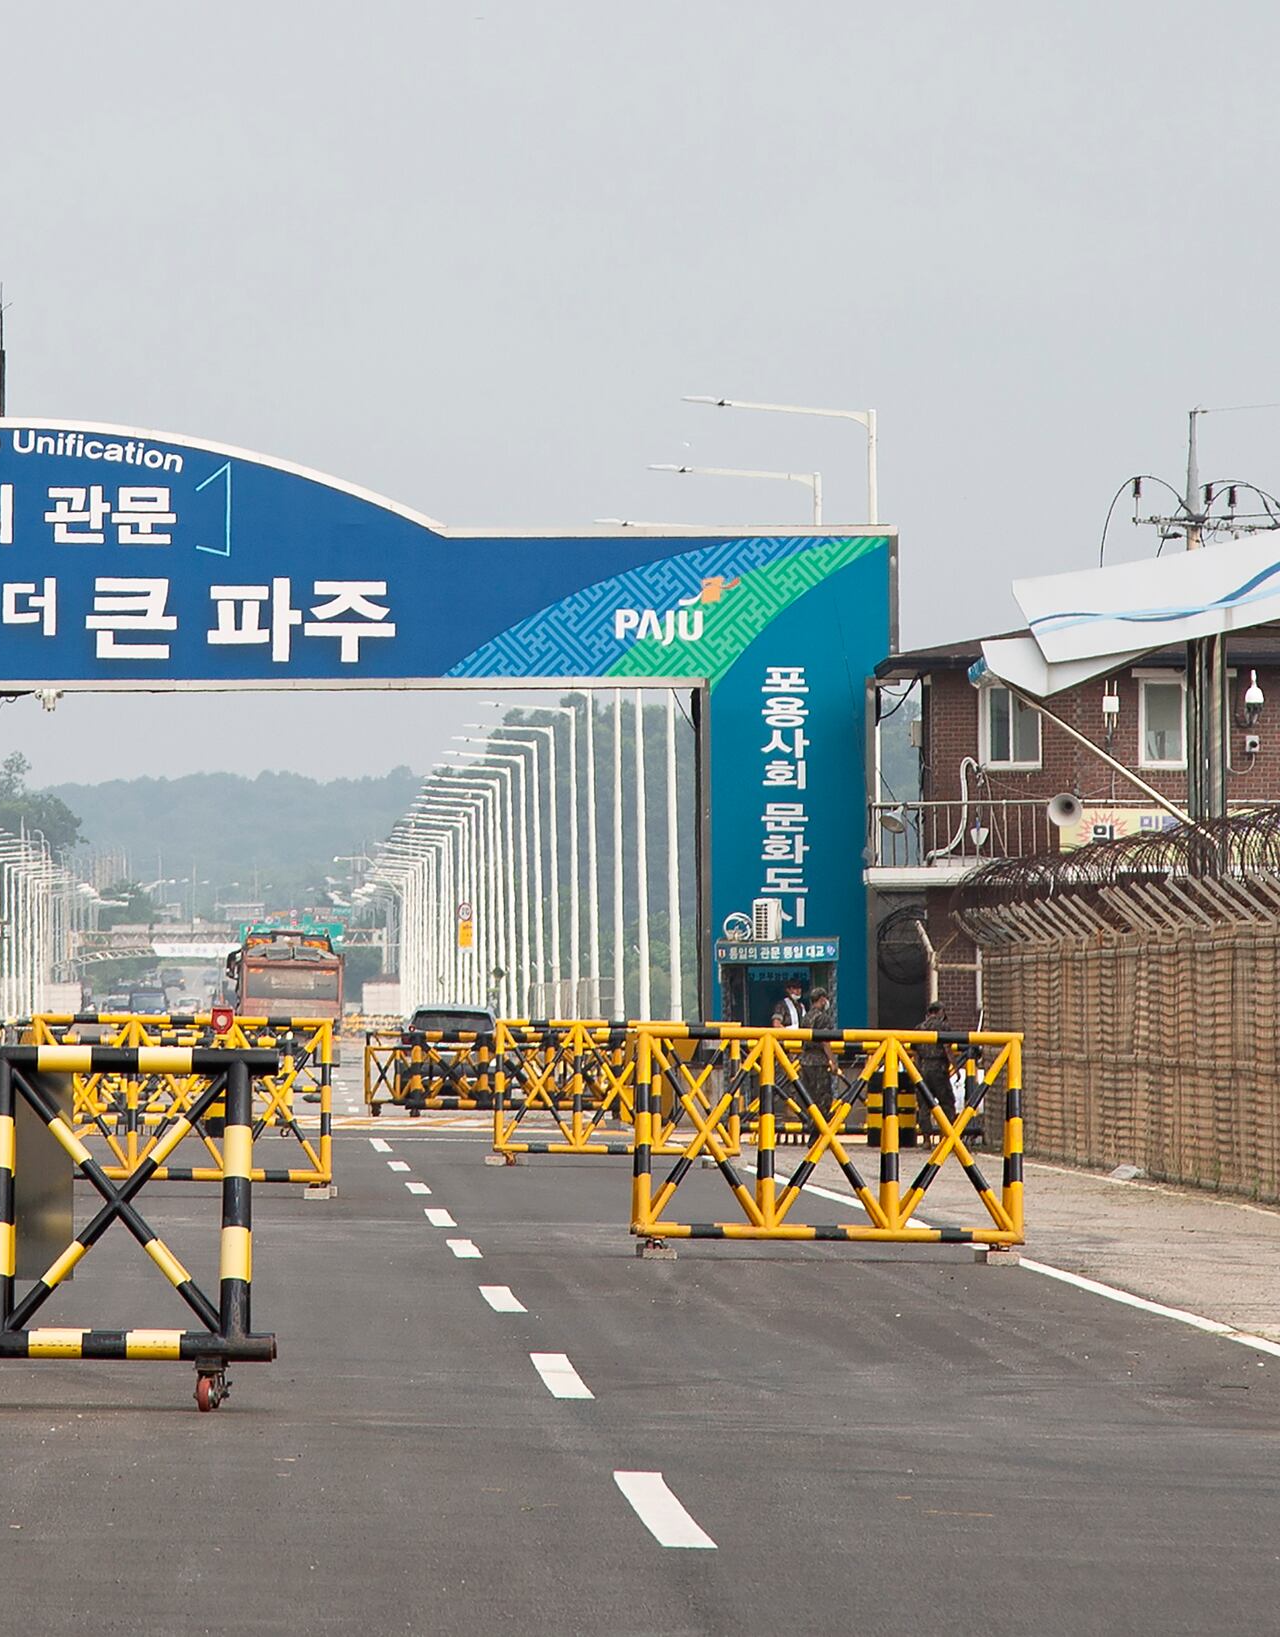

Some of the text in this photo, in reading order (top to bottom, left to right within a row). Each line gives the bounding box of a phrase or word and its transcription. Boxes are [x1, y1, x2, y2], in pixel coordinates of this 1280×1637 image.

[12, 428, 183, 473] Unification
[44, 486, 177, 545] 관문
[3, 578, 57, 636] 더
[85, 578, 178, 660] 큰
[207, 578, 397, 663] 파주
[615, 608, 704, 645] PAJU
[761, 667, 810, 790] 포용사회
